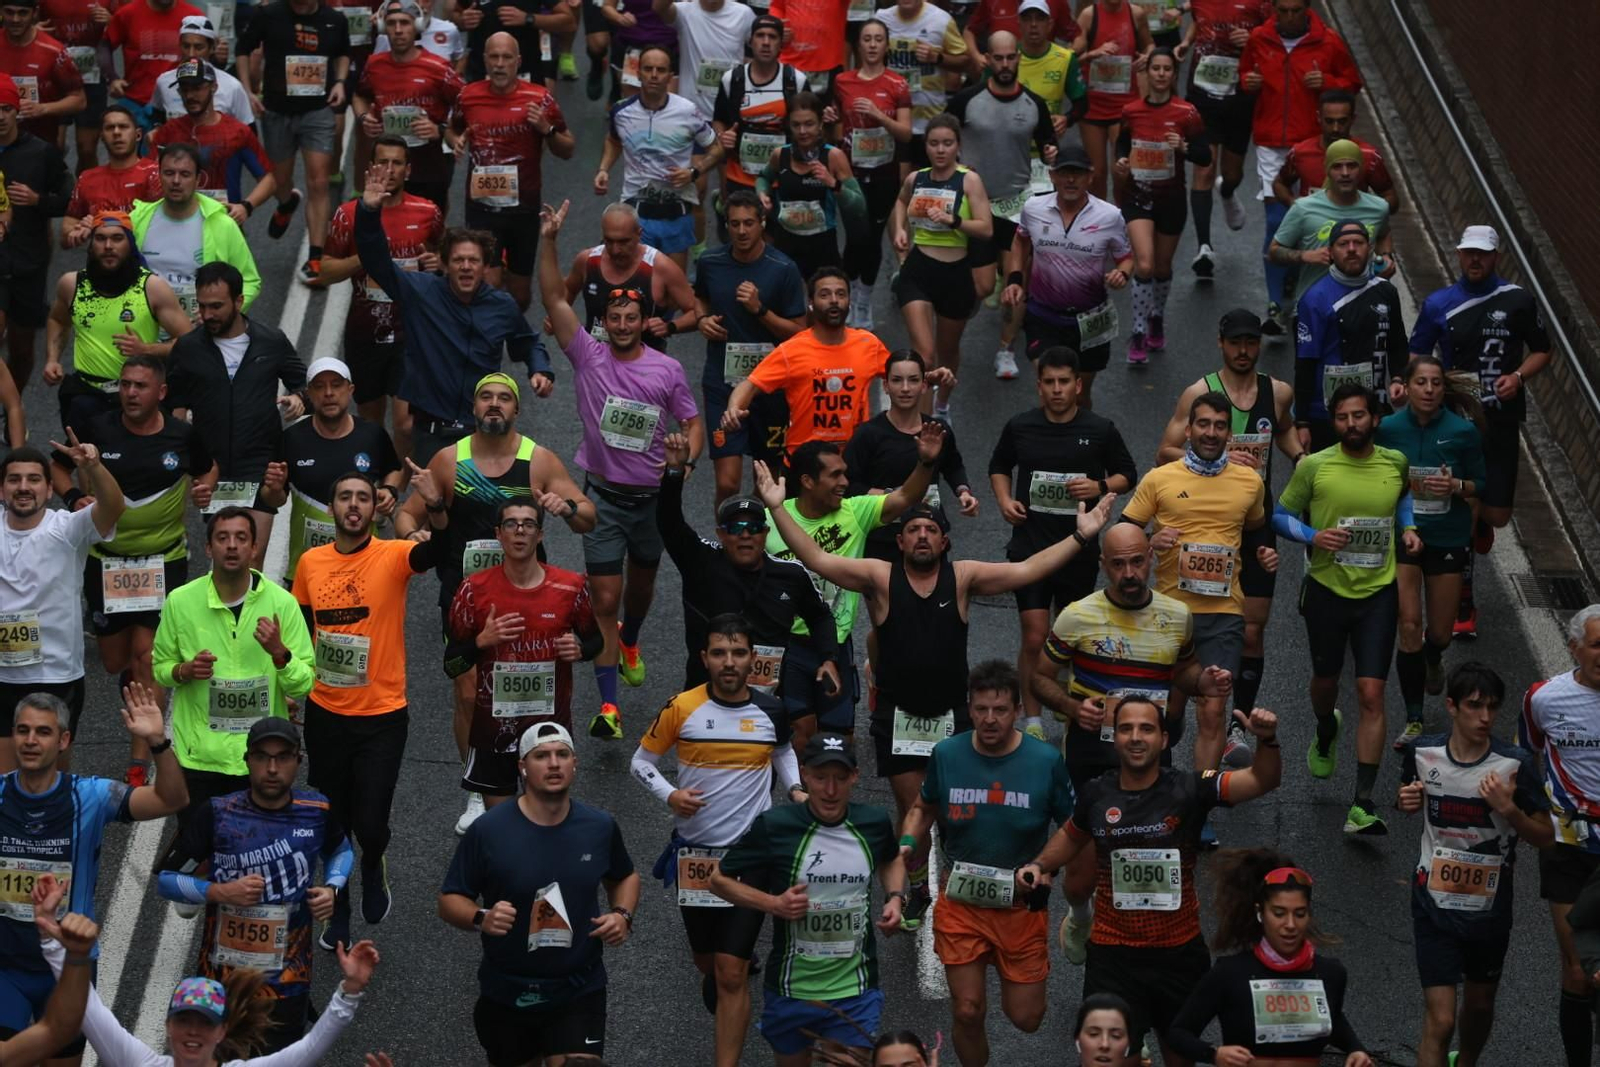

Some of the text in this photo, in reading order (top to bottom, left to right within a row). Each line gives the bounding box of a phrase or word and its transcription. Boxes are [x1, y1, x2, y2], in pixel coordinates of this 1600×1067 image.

[293, 65, 320, 78] 4734
[478, 177, 507, 190] 5632
[813, 396, 853, 411] TUR
[609, 409, 645, 429] 8758
[813, 413, 842, 428] NA
[1188, 555, 1223, 573] 5265
[112, 573, 150, 590] 5032
[320, 645, 356, 667] 7292
[502, 675, 542, 693] 8506
[217, 691, 258, 709] 8964
[904, 716, 941, 733] 7407
[948, 805, 977, 821] 70.3
[292, 829, 315, 838] HOKA
[2, 844, 26, 853] COSTA
[239, 836, 293, 869] MARATÓN
[806, 873, 865, 885] Trent Park
[1122, 864, 1165, 883] 8050
[1440, 863, 1485, 886] 6018
[2, 874, 37, 895] 113
[957, 877, 998, 901] 7186
[227, 922, 270, 942] 5158
[803, 914, 854, 933] 10281
[1264, 994, 1312, 1013] 8903
